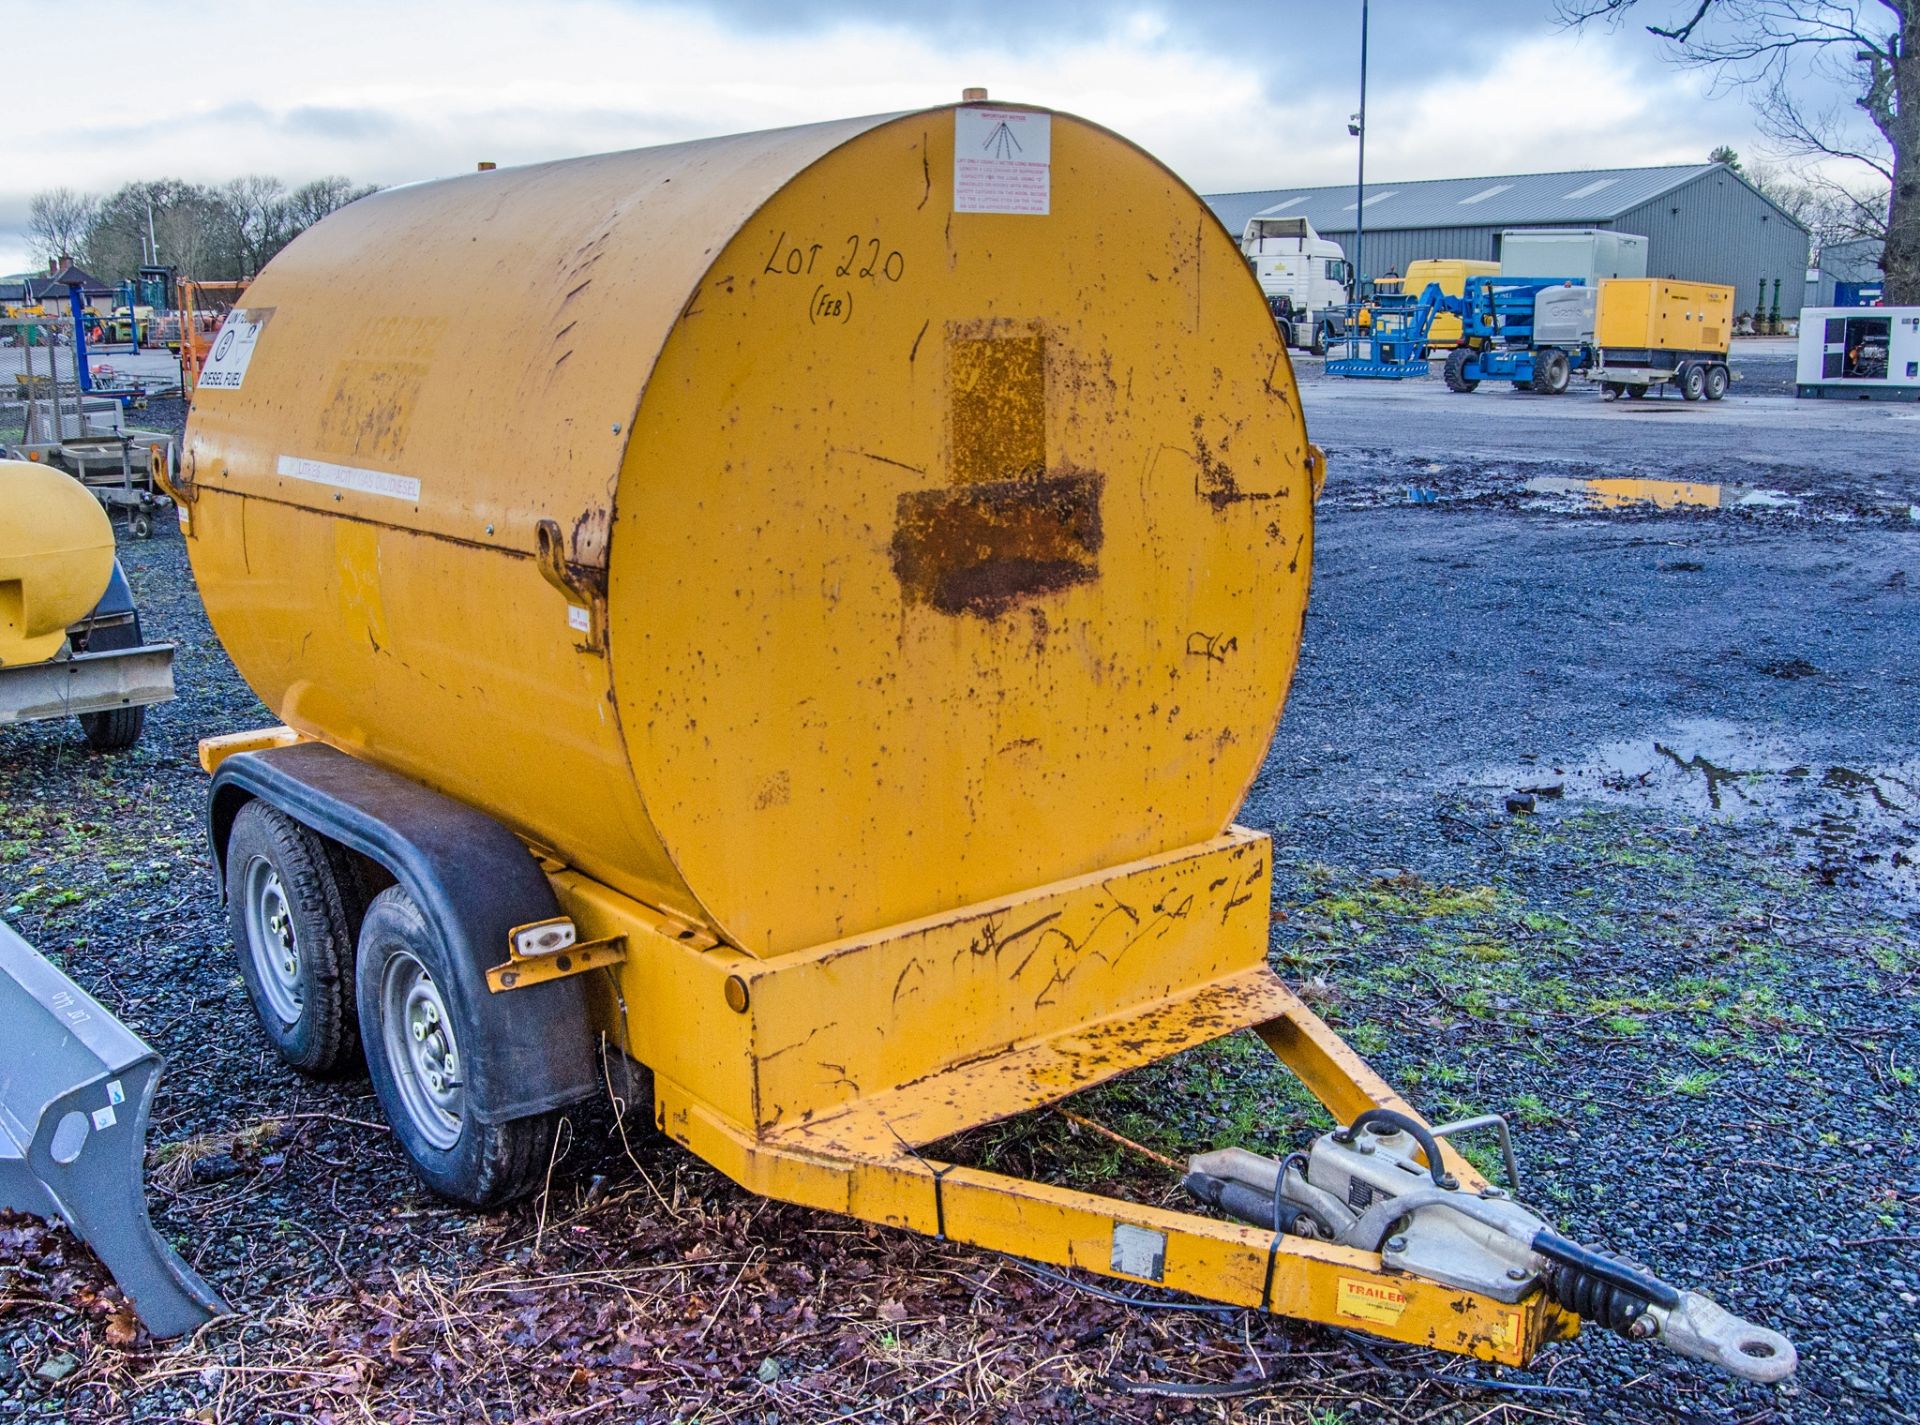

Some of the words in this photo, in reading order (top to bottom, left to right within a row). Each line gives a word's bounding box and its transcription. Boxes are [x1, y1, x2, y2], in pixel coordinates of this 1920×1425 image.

[836, 234, 904, 282] 220
[809, 284, 853, 325] (FEB)
[200, 371, 224, 386] DIESEL
[223, 371, 241, 386] FUEL
[1347, 1283, 1406, 1304] TRAILER
